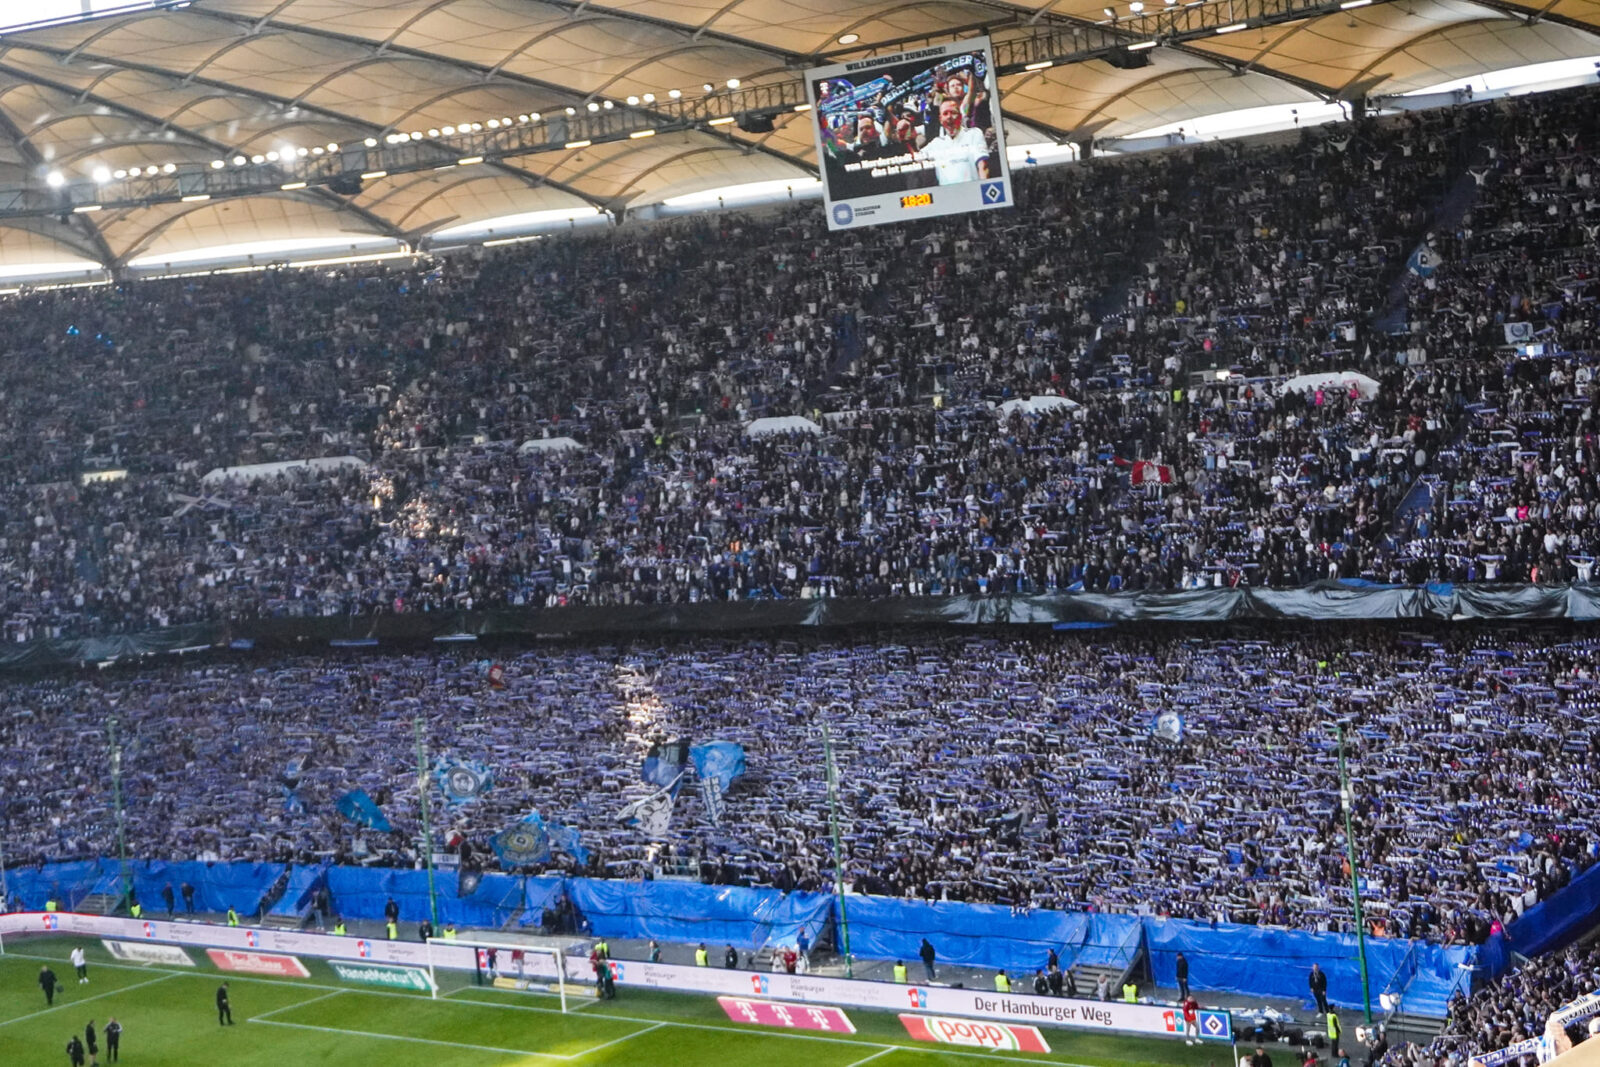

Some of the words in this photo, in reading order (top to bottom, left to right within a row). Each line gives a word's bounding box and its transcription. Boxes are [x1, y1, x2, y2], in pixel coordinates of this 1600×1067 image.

[845, 54, 903, 71] WILLKOMMEN
[336, 966, 409, 984] HanseMerkur
[975, 997, 998, 1011] Der
[1002, 999, 1077, 1021] Hamburger
[1081, 1006, 1113, 1026] Weg
[938, 1021, 1003, 1047] popp
